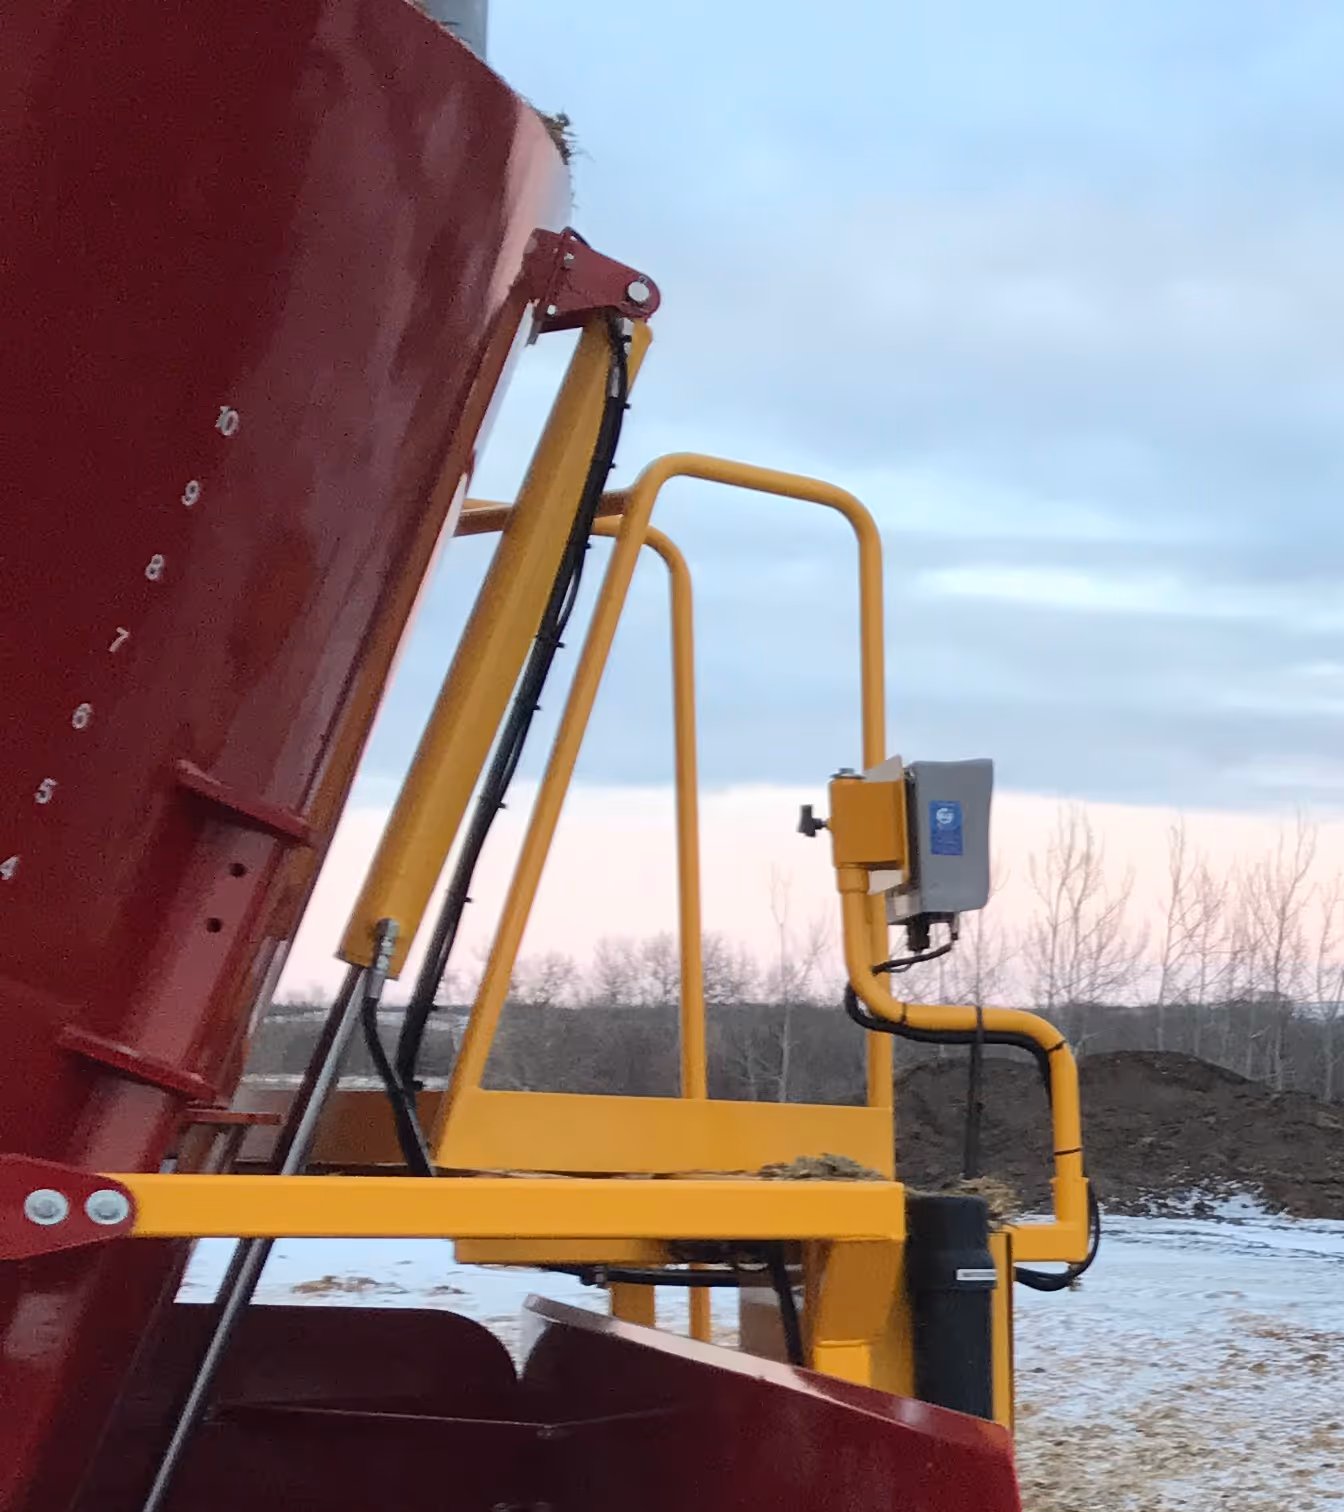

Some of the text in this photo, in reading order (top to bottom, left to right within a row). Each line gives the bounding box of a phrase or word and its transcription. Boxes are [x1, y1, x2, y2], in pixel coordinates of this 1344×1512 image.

[214, 405, 239, 436] 10
[181, 480, 201, 507] 9
[145, 554, 165, 581] 8
[109, 626, 130, 653] 7
[72, 703, 93, 730] 6
[36, 777, 58, 804] 5
[0, 855, 19, 881] 4
